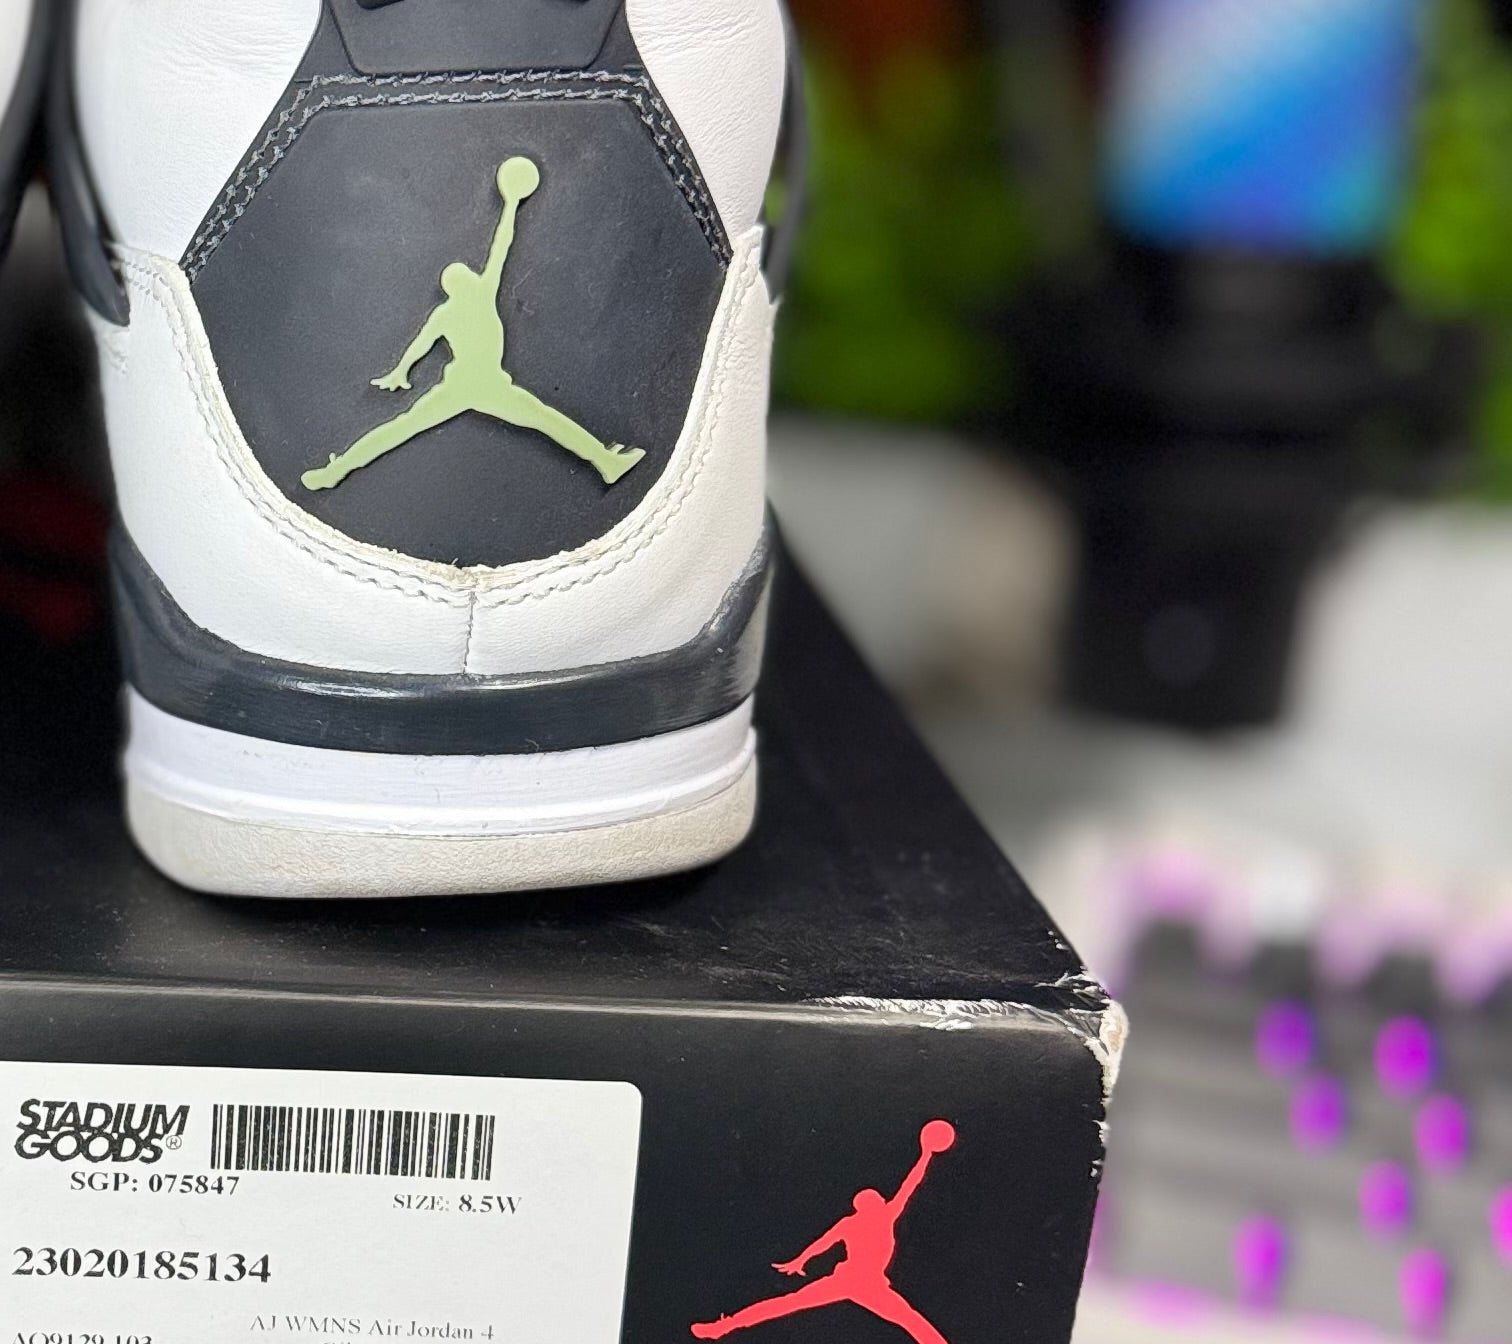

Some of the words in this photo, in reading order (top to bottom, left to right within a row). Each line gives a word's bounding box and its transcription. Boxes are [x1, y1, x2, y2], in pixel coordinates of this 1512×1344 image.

[16, 1098, 190, 1136] STADIUM
[70, 1171, 138, 1193] SGP:
[148, 1174, 240, 1196] 075847
[393, 1193, 450, 1213] SIZE:
[458, 1194, 522, 1215] 8.5W
[12, 1246, 272, 1284] 23020185134
[250, 1314, 278, 1332] AJ
[285, 1315, 361, 1335] WMNS
[368, 1319, 401, 1337] Air
[405, 1321, 474, 1341] Jordan
[479, 1325, 494, 1341] 4
